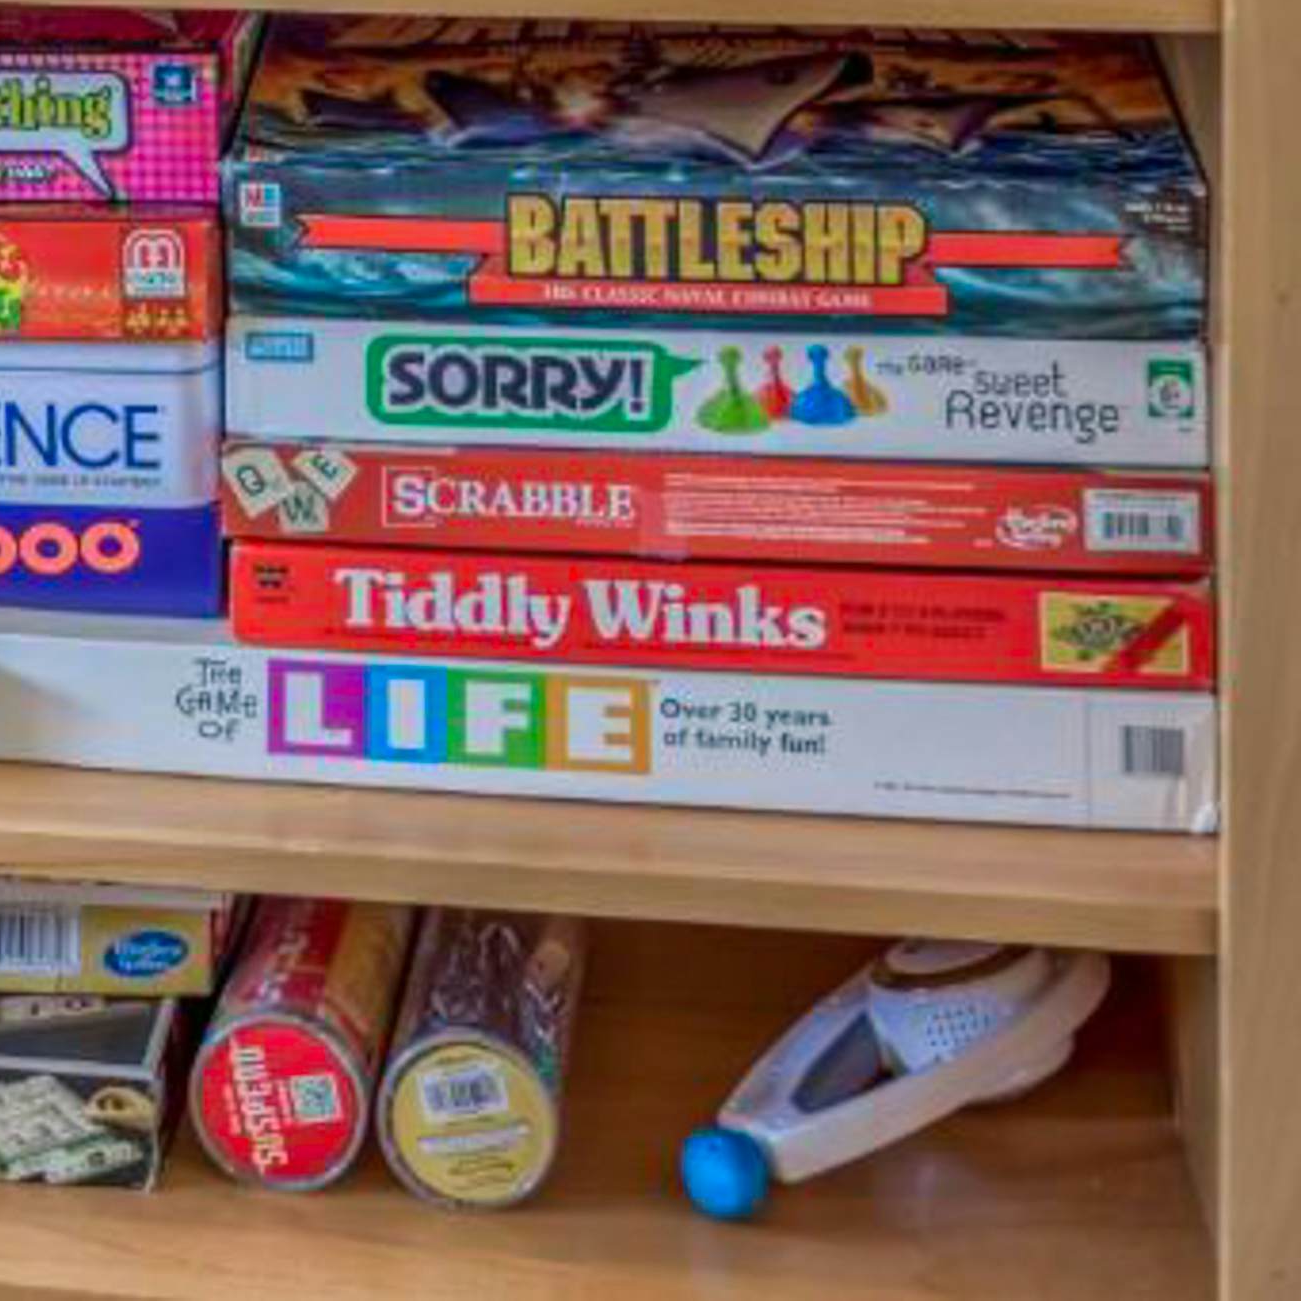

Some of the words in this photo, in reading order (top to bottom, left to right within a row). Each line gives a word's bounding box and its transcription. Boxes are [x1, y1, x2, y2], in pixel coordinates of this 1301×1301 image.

[510, 196, 929, 283] BATTLESHIP
[387, 353, 647, 416] SORRY!
[974, 361, 1069, 398] sweet
[945, 392, 1121, 444] Revenge
[392, 478, 633, 520] SCRABBLE
[334, 566, 569, 646] Tiddly
[579, 578, 827, 648] Winks
[176, 690, 257, 718] GAME
[283, 672, 635, 762] LIFE
[660, 698, 716, 720] Over
[728, 700, 758, 722] 30
[764, 706, 830, 730] years
[663, 729, 688, 750] of
[695, 729, 772, 756] family
[779, 732, 827, 754] fun!
[229, 1042, 287, 1172] SUSPEND
